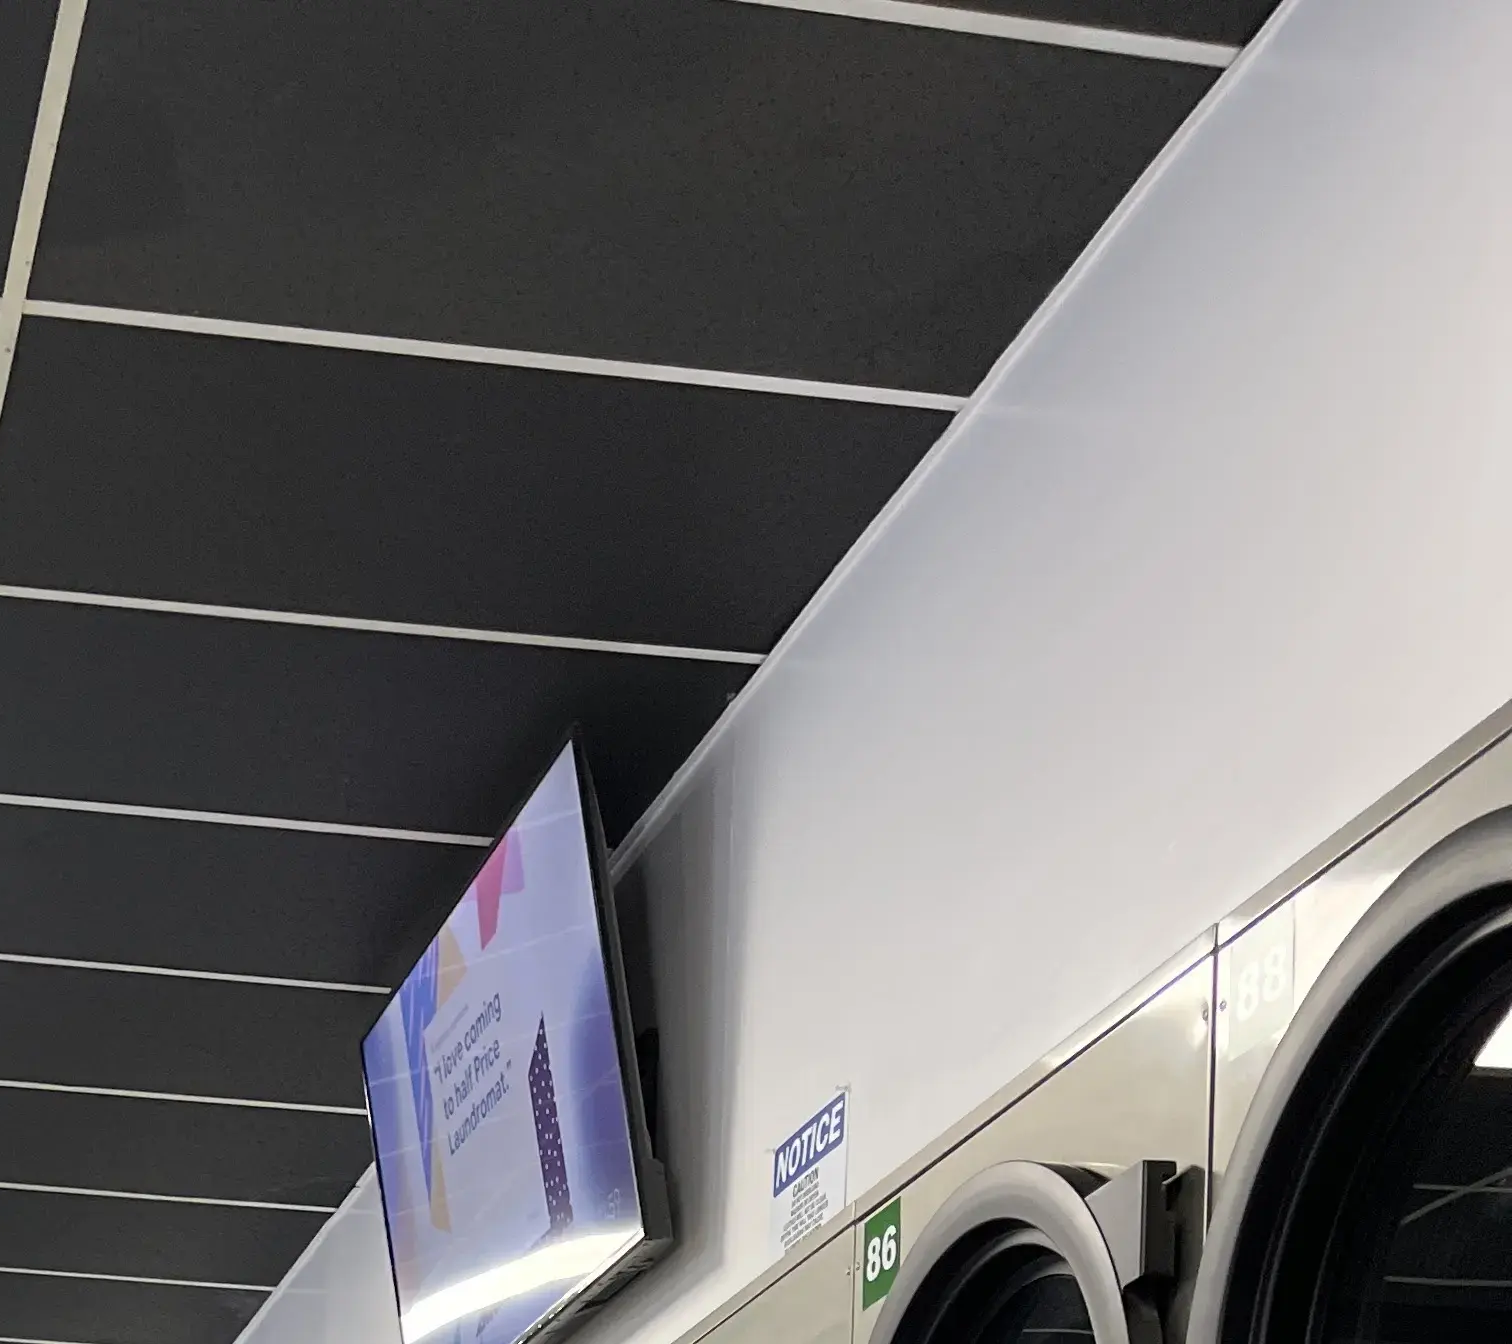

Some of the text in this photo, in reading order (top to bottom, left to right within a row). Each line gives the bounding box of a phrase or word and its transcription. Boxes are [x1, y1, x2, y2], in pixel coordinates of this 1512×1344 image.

[441, 1041, 464, 1081] love
[463, 992, 502, 1051] coming
[443, 1038, 500, 1120] to half Price
[774, 1099, 845, 1188] NOTICE
[866, 1225, 897, 1282] 86
